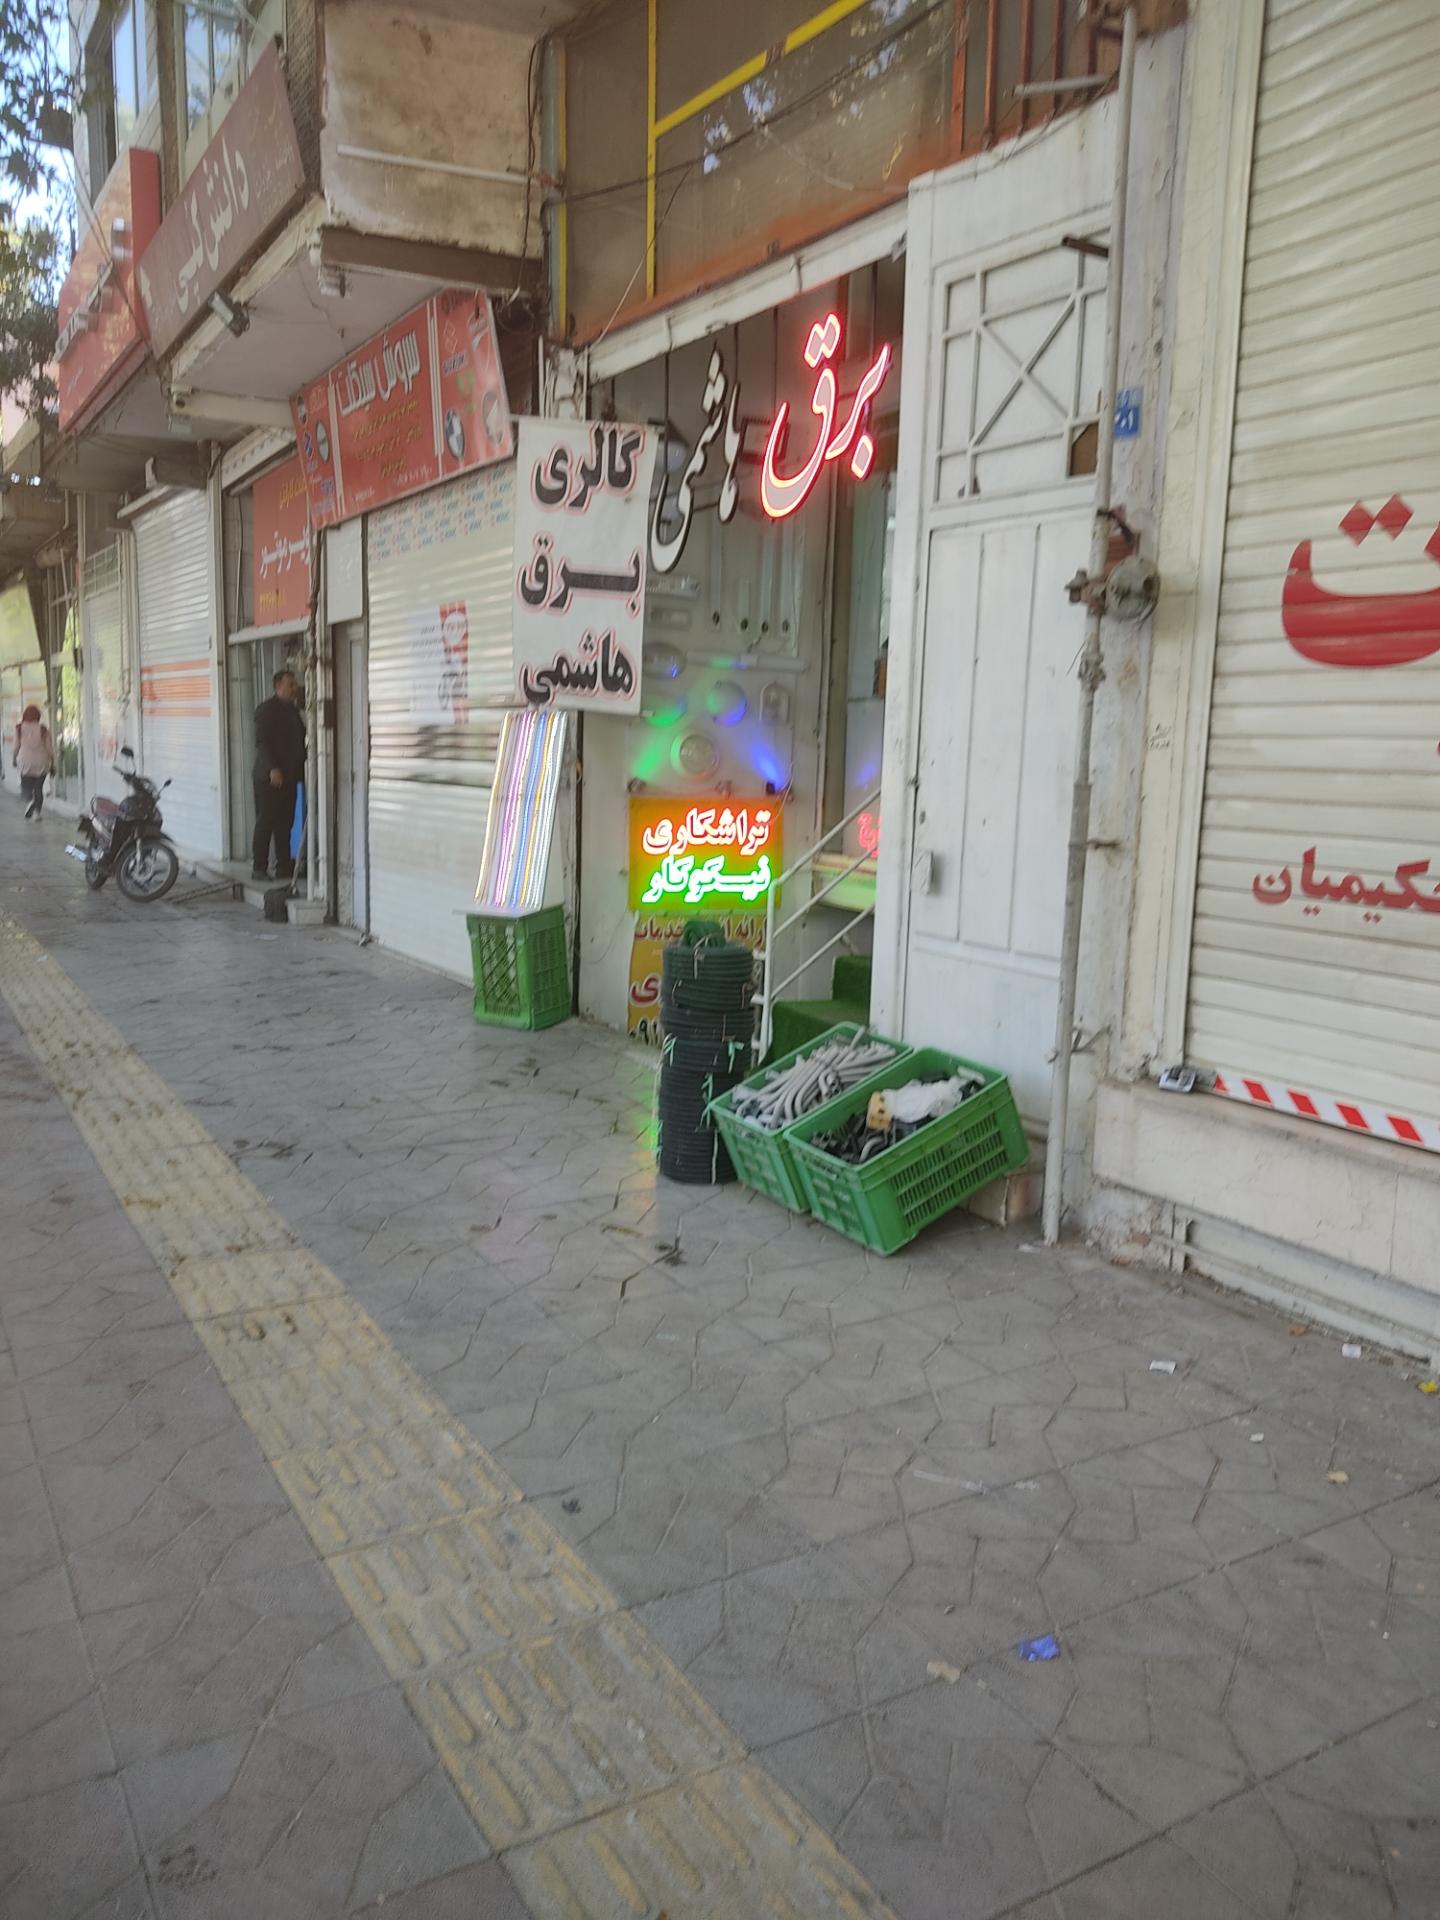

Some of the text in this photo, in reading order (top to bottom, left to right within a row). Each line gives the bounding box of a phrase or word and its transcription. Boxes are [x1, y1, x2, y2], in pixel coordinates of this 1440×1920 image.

[203, 135, 249, 272] دانش
[761, 312, 891, 518] برق
[533, 424, 643, 509] گالری
[650, 348, 741, 574] هاشمی
[519, 533, 641, 612] برق
[521, 630, 634, 705] هاشمی
[643, 808, 771, 855] تراشکاری
[1252, 846, 1440, 924] کیمیان
